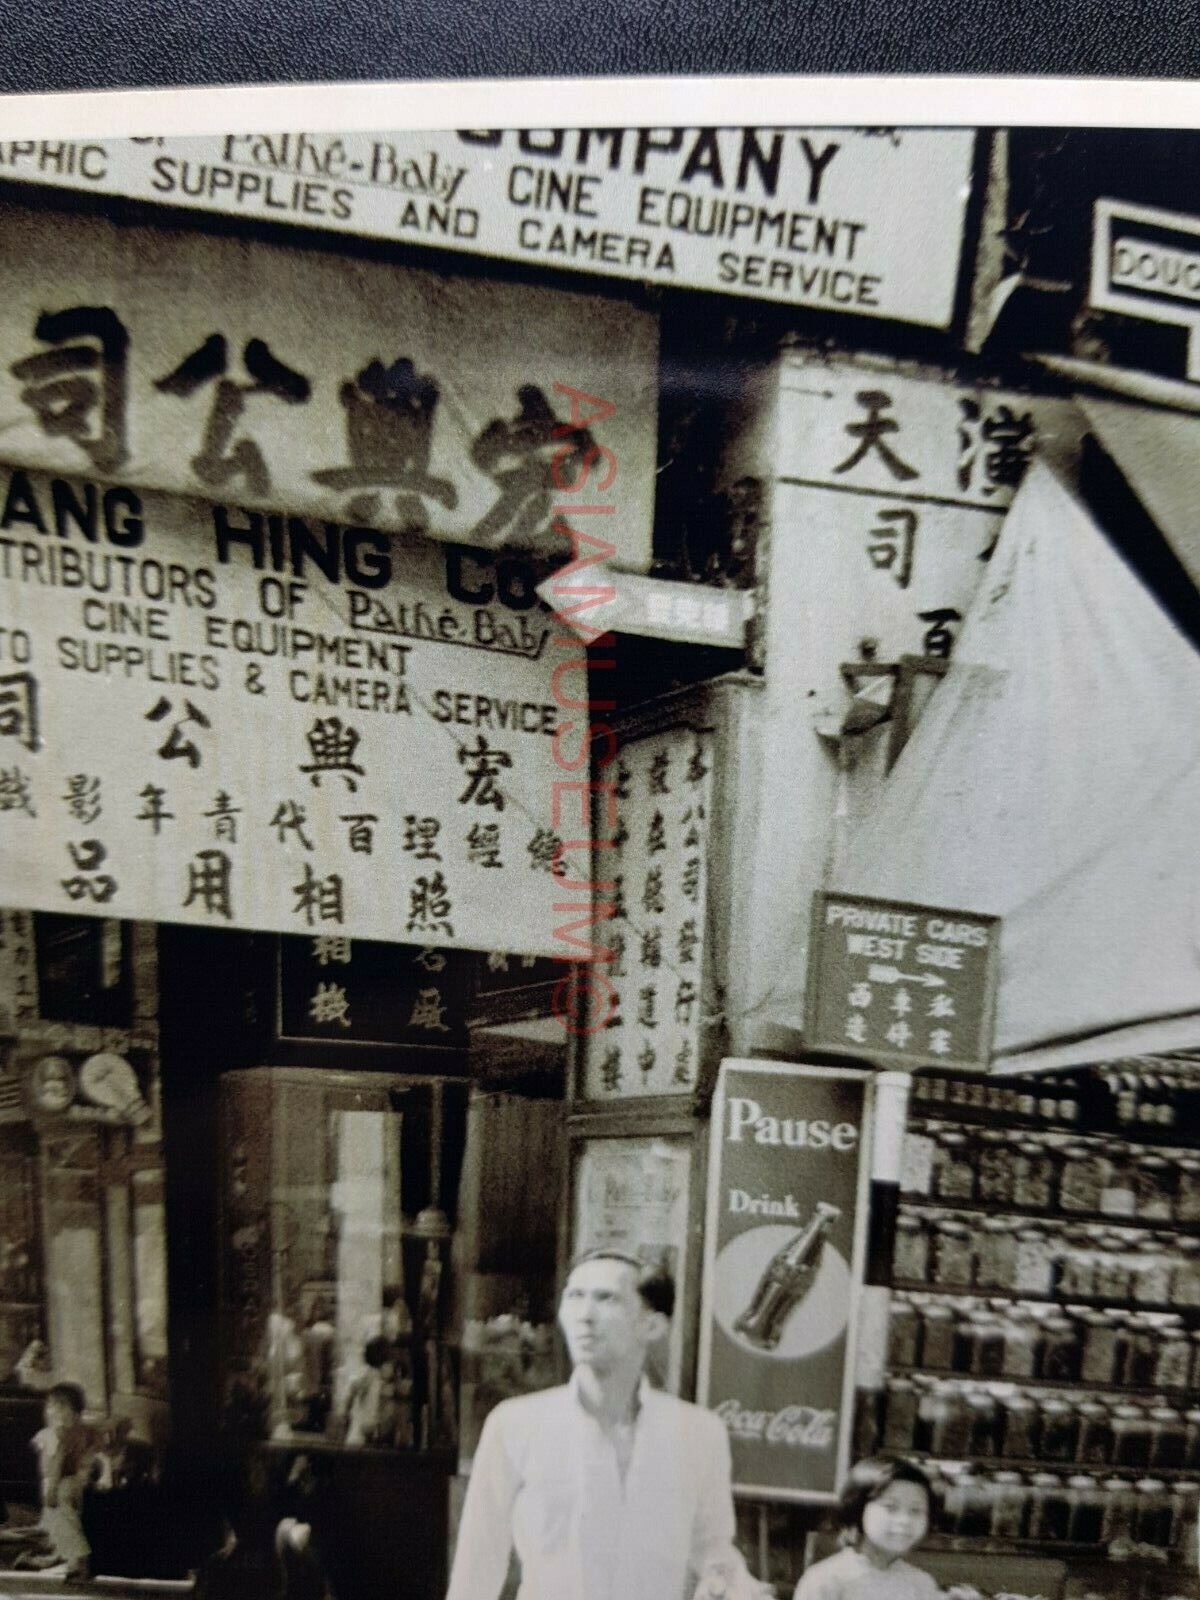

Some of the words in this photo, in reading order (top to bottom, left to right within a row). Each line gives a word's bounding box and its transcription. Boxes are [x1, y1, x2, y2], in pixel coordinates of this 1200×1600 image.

[151, 156, 353, 221] SUPPLIES
[400, 200, 479, 240] AND
[518, 219, 676, 273] CAMERA
[717, 251, 882, 307] SERVICE
[508, 164, 602, 218] CINE
[637, 187, 866, 262] EQUIPMENT
[0, 470, 146, 547] ANG
[212, 504, 393, 590] HING
[259, 576, 308, 620] OF
[83, 598, 171, 641] CINE
[205, 615, 412, 676] EQUIPMENT
[57, 635, 220, 692] SUPPLIES
[245, 662, 266, 696] &
[289, 670, 412, 716] CAMERA
[430, 689, 558, 737] SERVICE
[826, 905, 919, 938] PRIVATE
[926, 918, 989, 948] CARS
[846, 934, 908, 961] WEST
[727, 1097, 858, 1151] Pause
[728, 1189, 799, 1218] Drink
